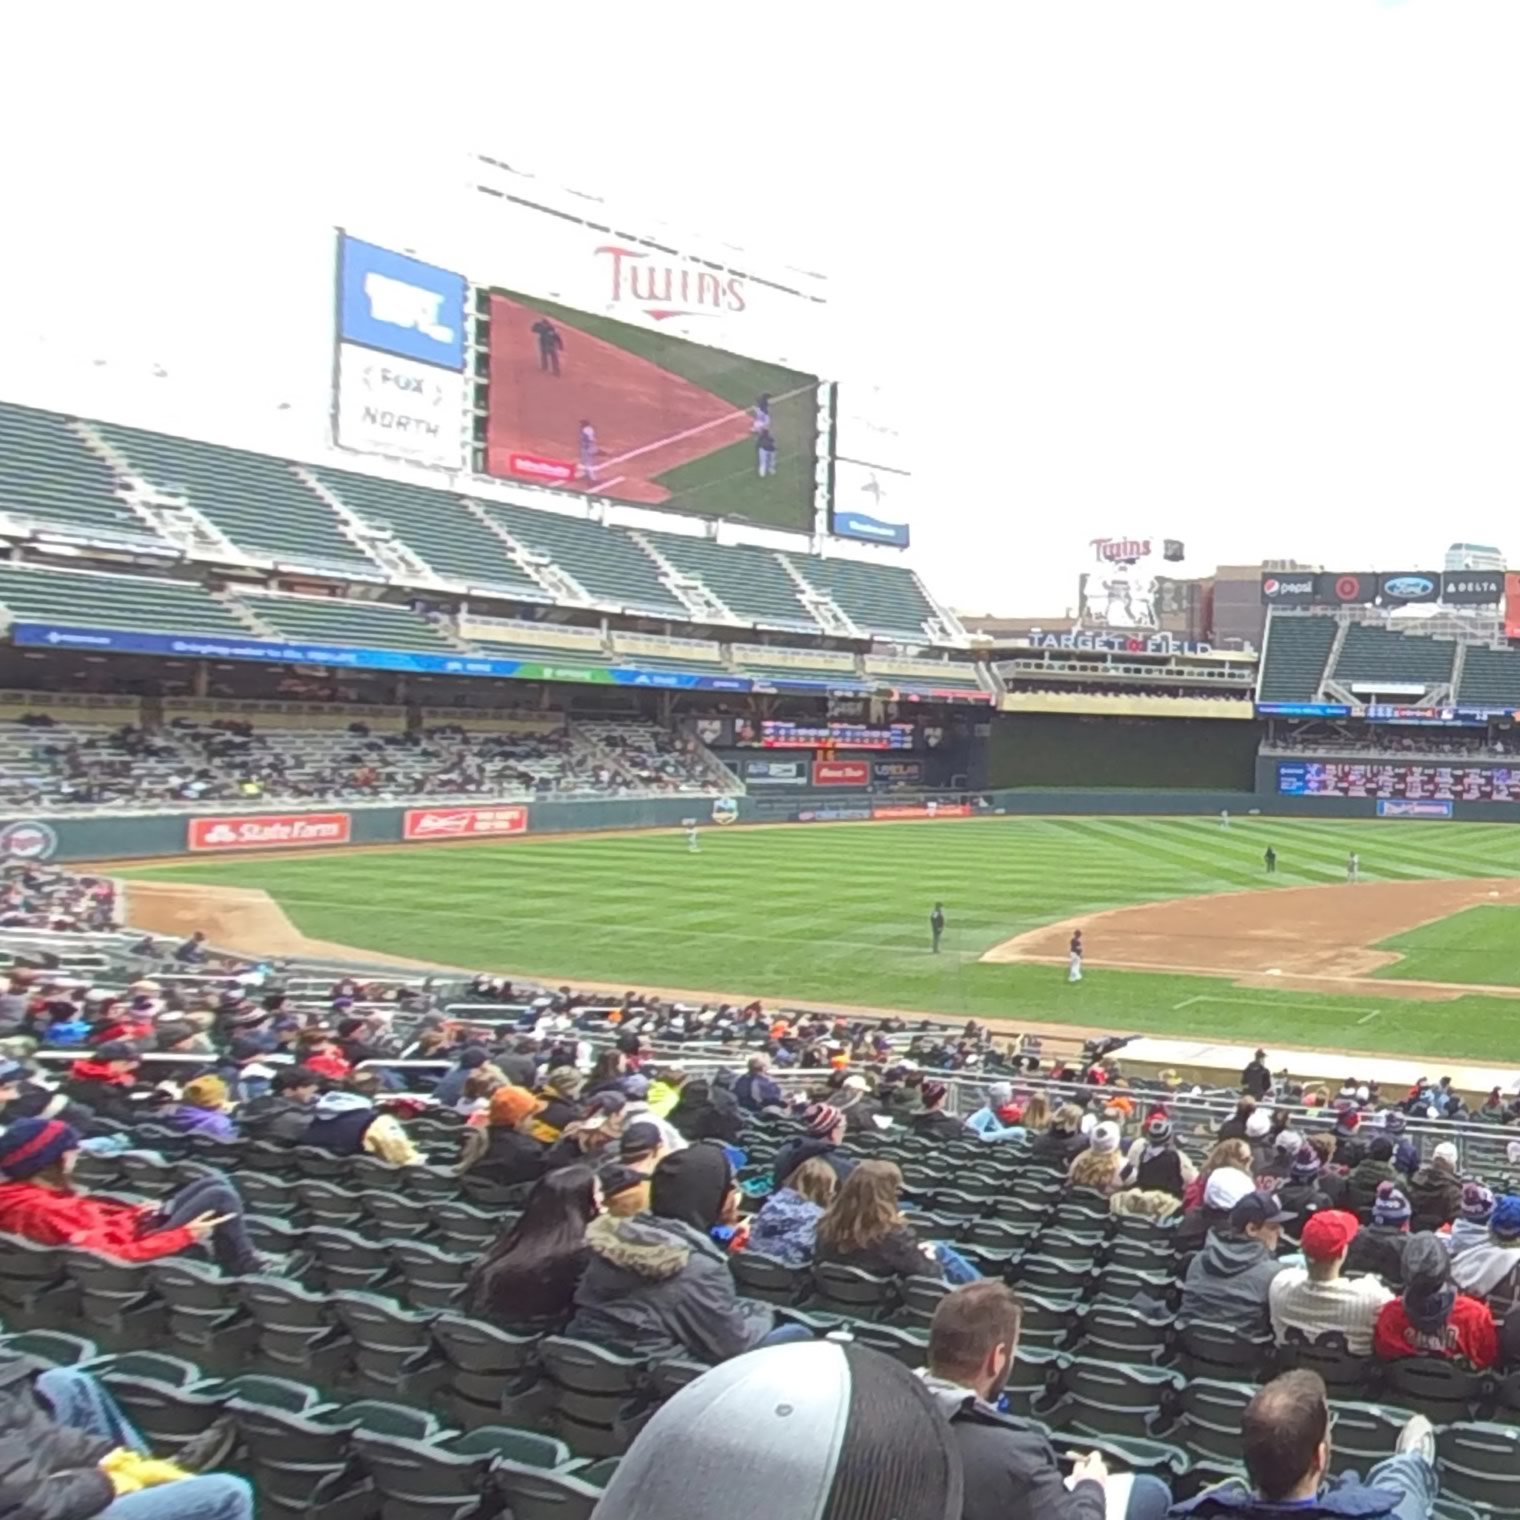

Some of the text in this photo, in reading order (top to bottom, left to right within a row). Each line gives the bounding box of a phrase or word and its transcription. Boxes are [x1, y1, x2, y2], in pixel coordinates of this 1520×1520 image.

[594, 246, 746, 312] Twins
[380, 368, 424, 394] FOX
[362, 406, 440, 436] NORTH
[1089, 537, 1152, 562] Twins
[1280, 581, 1313, 595] pepsi
[1458, 581, 1498, 592] DELTA
[1028, 633, 1213, 656] TARGET FIELD
[237, 821, 340, 842] State Farm
